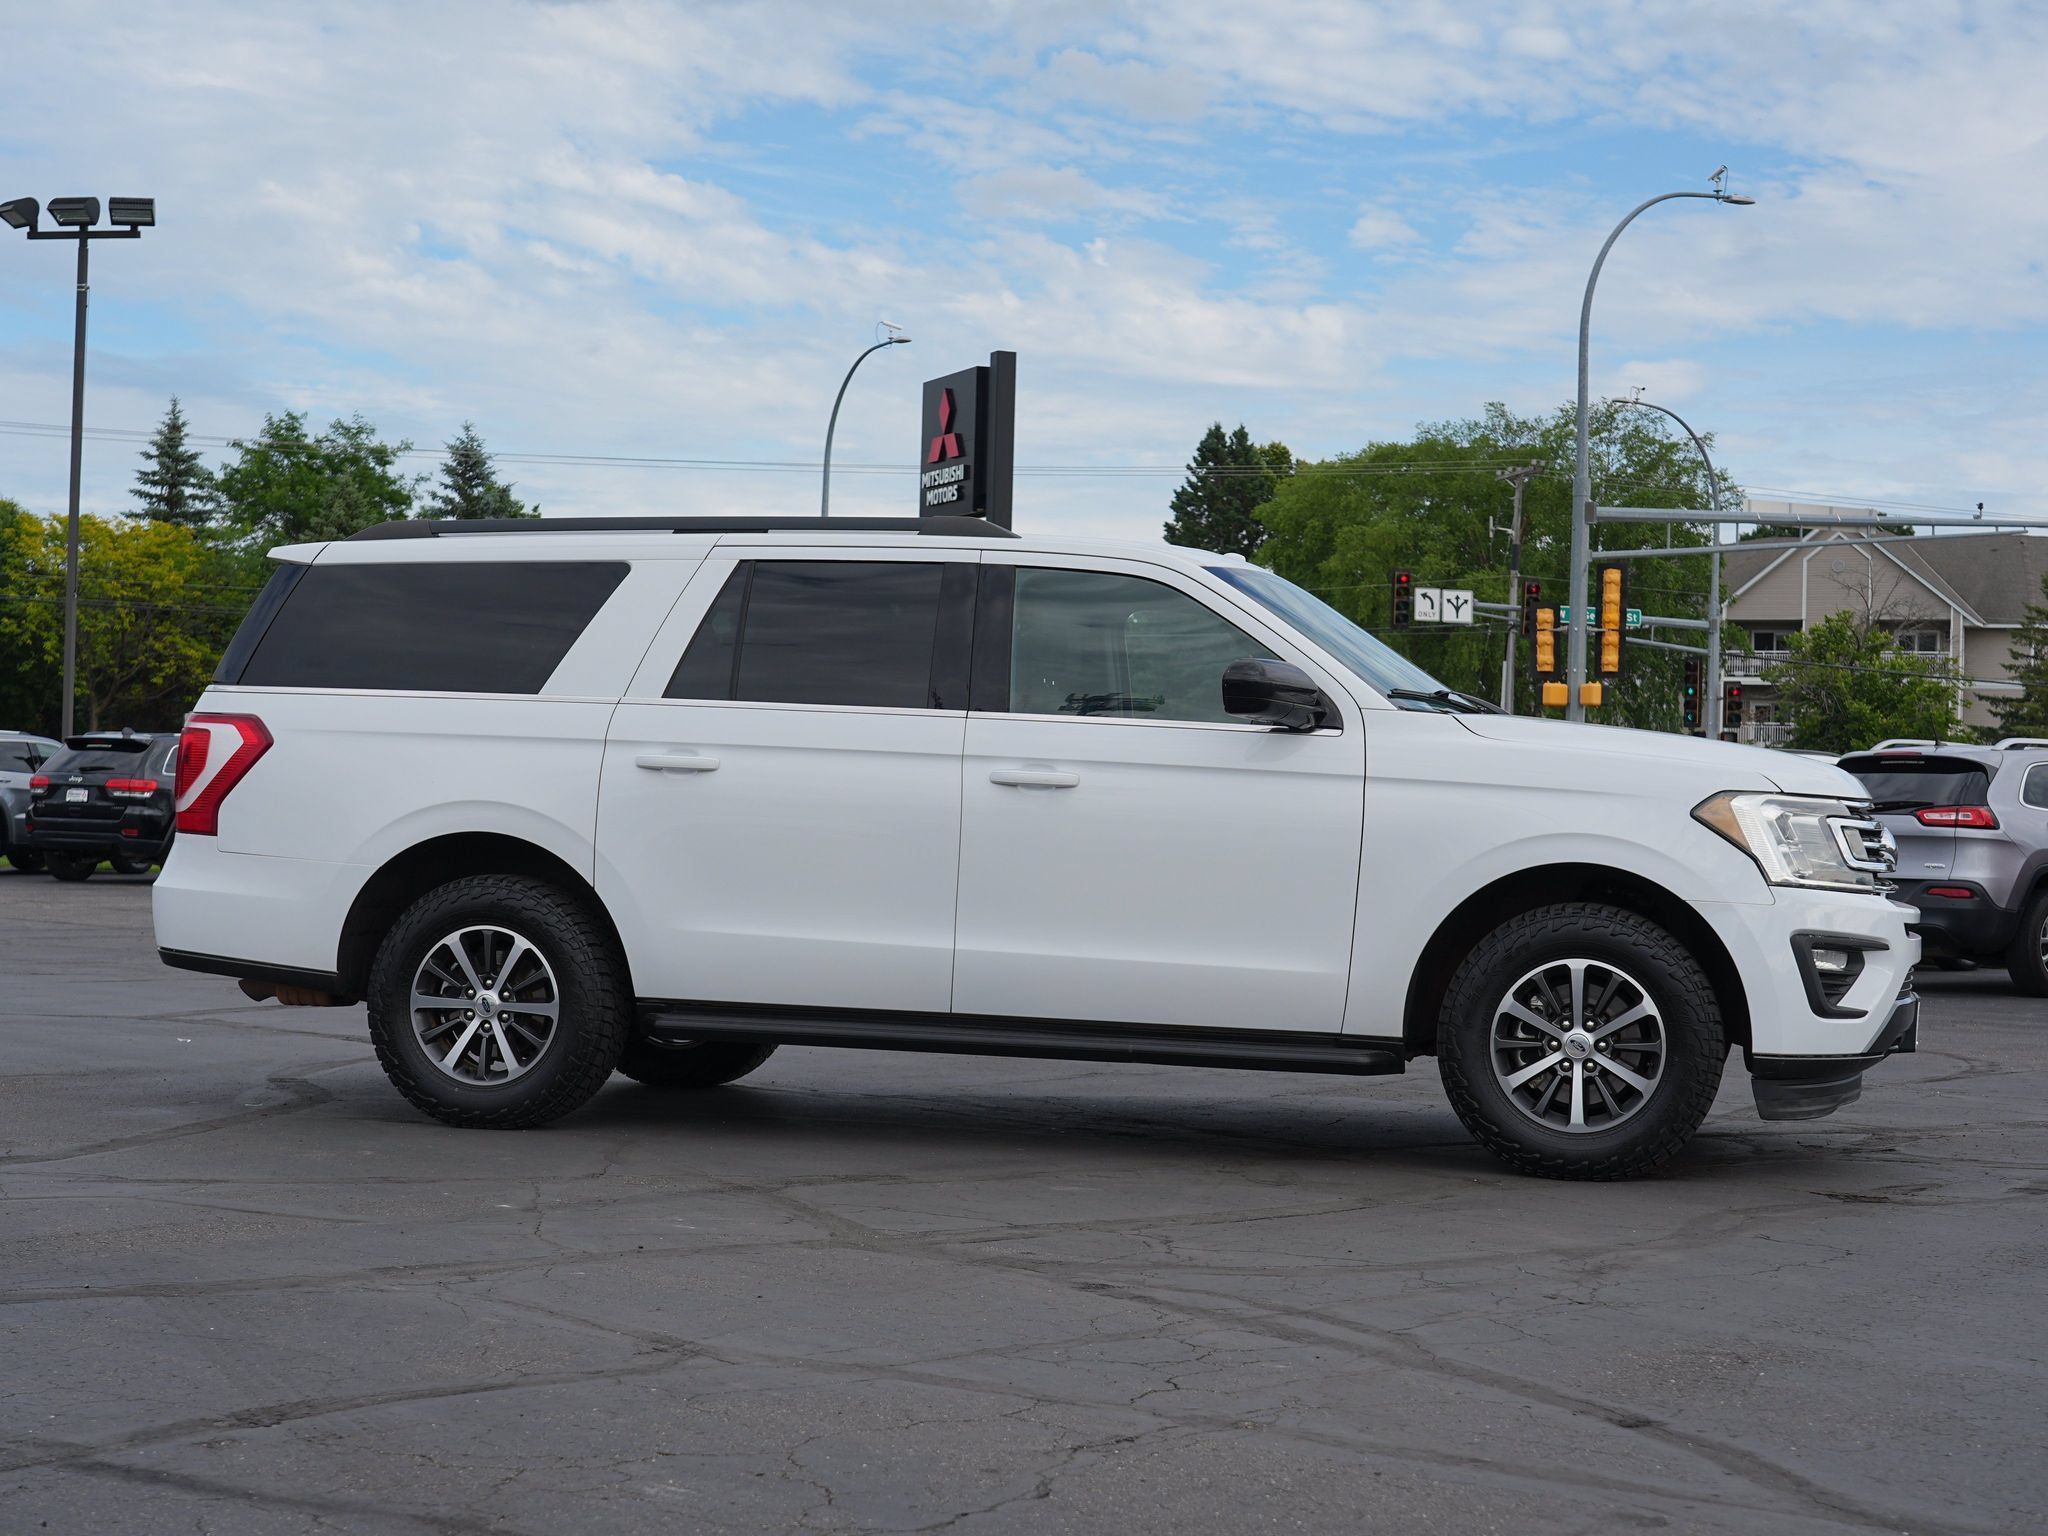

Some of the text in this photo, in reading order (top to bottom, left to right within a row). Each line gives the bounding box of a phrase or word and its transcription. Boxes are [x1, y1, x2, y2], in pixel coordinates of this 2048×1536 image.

[922, 464, 964, 489] MITSUBISHI
[926, 484, 957, 506] MOTORS
[1627, 613, 1637, 622] St
